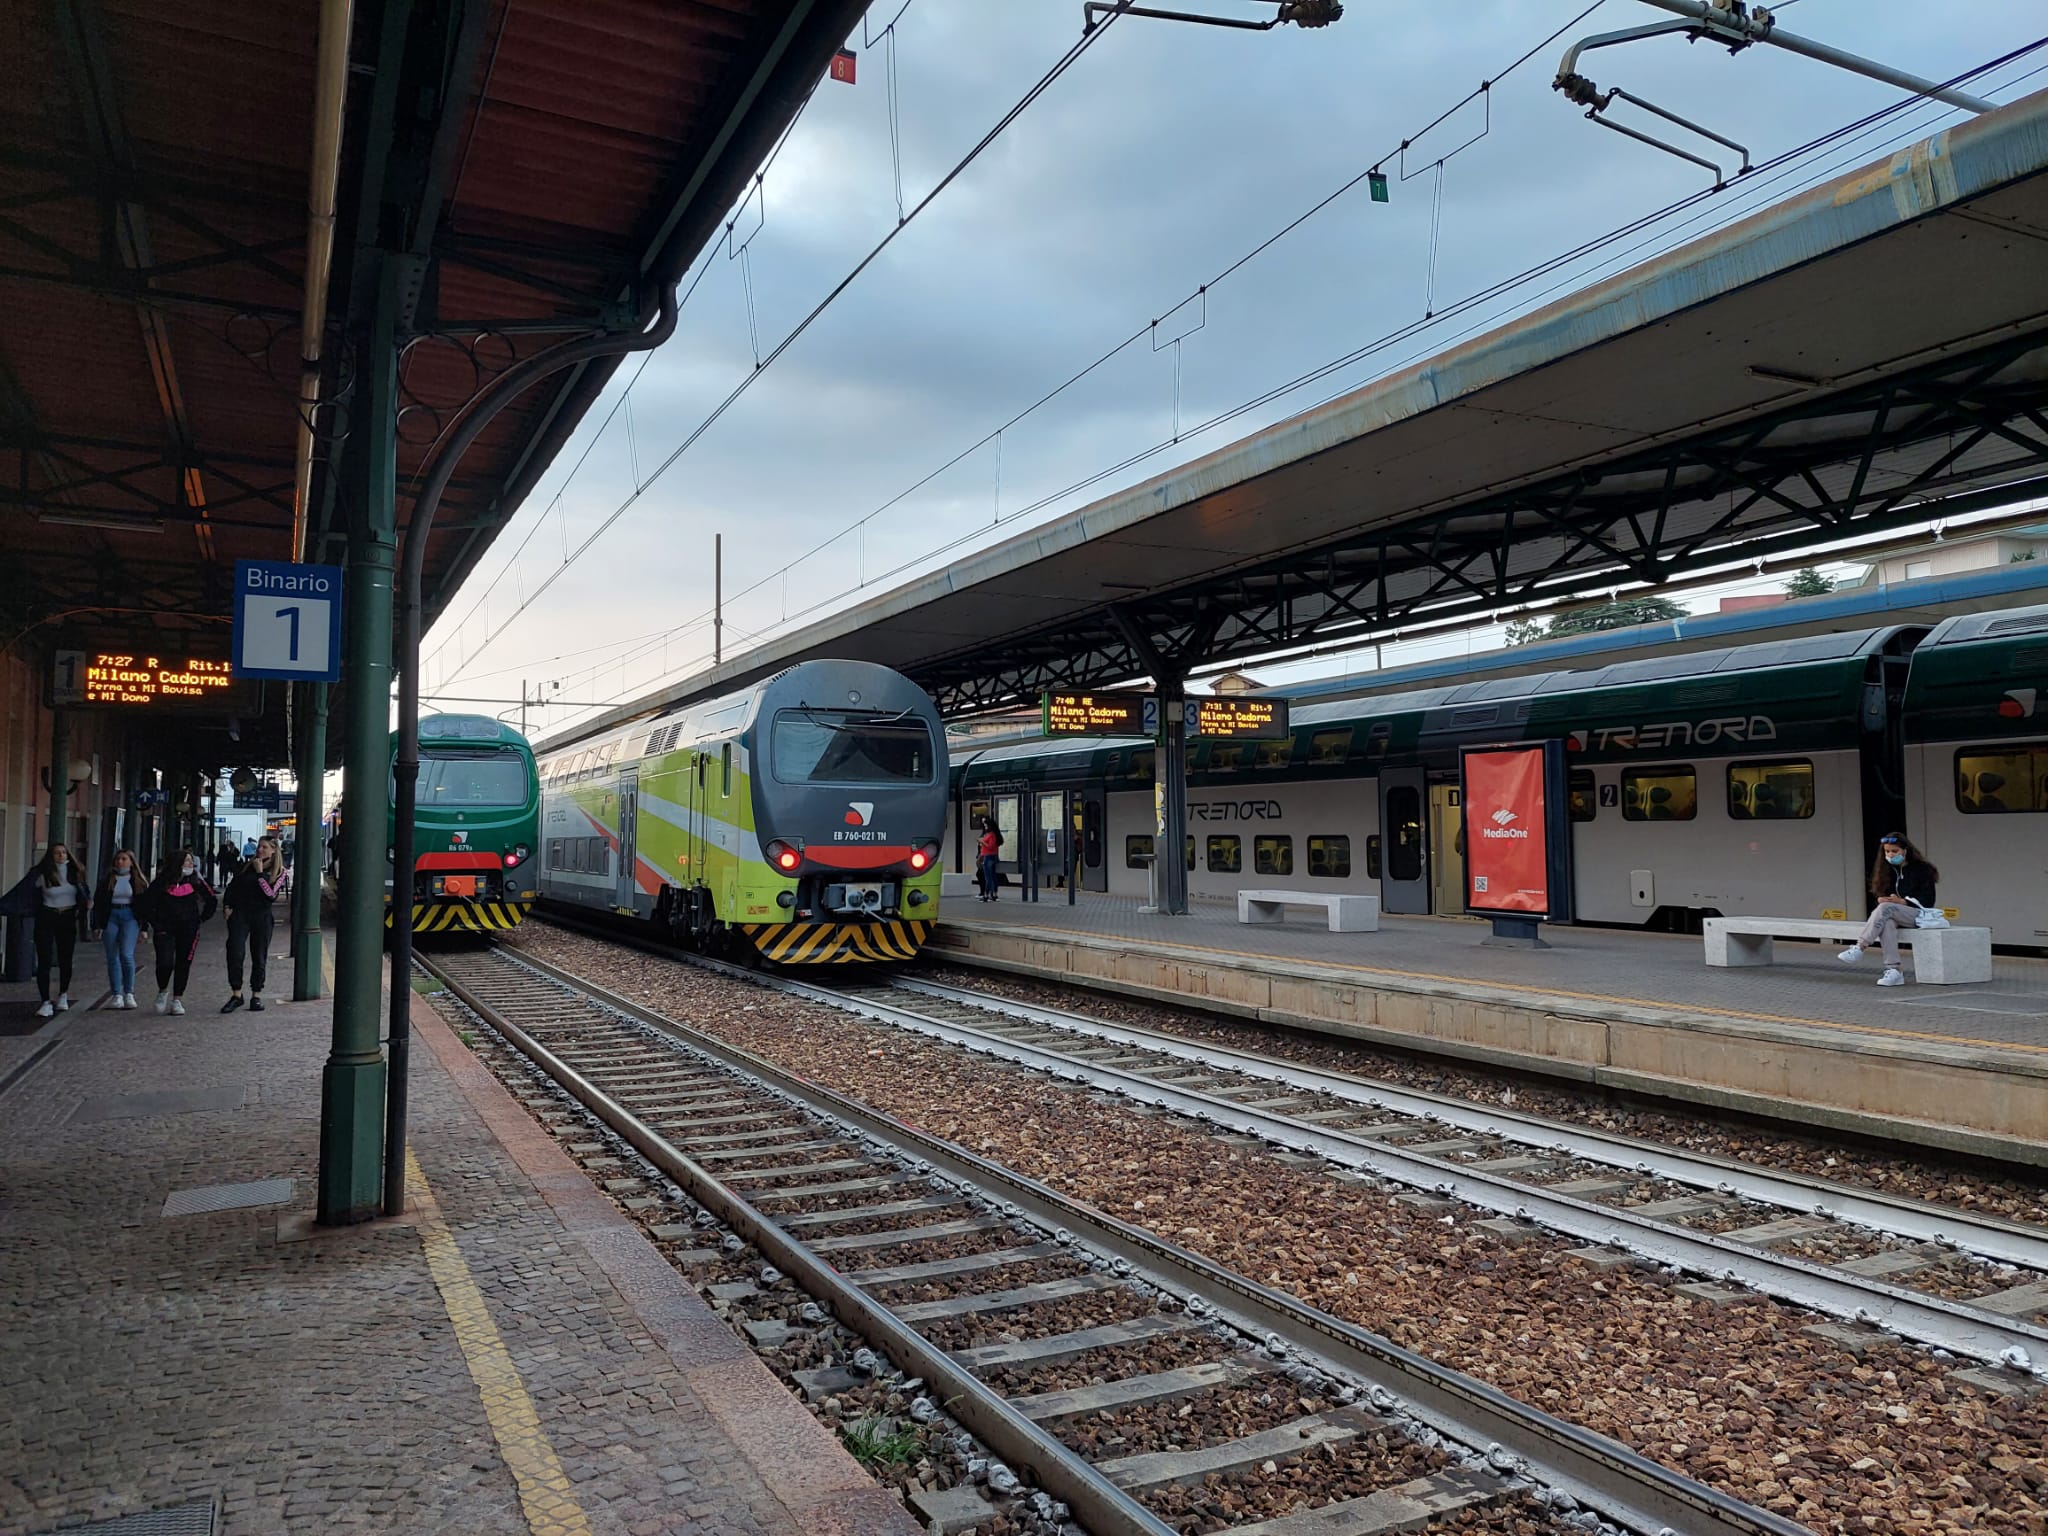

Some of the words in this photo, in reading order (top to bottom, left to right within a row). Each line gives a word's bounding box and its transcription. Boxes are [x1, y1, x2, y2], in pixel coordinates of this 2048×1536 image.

[248, 568, 328, 592] Binario
[275, 606, 300, 661] 1
[98, 655, 134, 666] 7:27
[148, 658, 158, 668] R
[59, 656, 75, 688] 1
[88, 668, 150, 682] Milano
[160, 672, 228, 686] Cadorna
[88, 682, 122, 692] Ferma
[143, 684, 156, 693] MI
[163, 685, 203, 695] Bovisa
[102, 693, 115, 701] MI
[1056, 697, 1074, 705] 7:40
[1082, 698, 1092, 706] RE
[1050, 706, 1084, 716] Milano
[1089, 707, 1127, 717] Cadorna
[1144, 702, 1156, 724] 2
[1205, 702, 1222, 710] 7:31
[1186, 704, 1197, 726] 3
[1200, 712, 1232, 720] Milano
[1236, 712, 1272, 722] Cadorna
[1594, 716, 1776, 750] TRENORD
[1604, 785, 1614, 806] 2
[1186, 800, 1282, 820] TRENORD
[834, 832, 842, 840] EB
[844, 832, 874, 840] 760-021
[877, 832, 887, 840] TN
[1484, 828, 1528, 838] MediaOne
